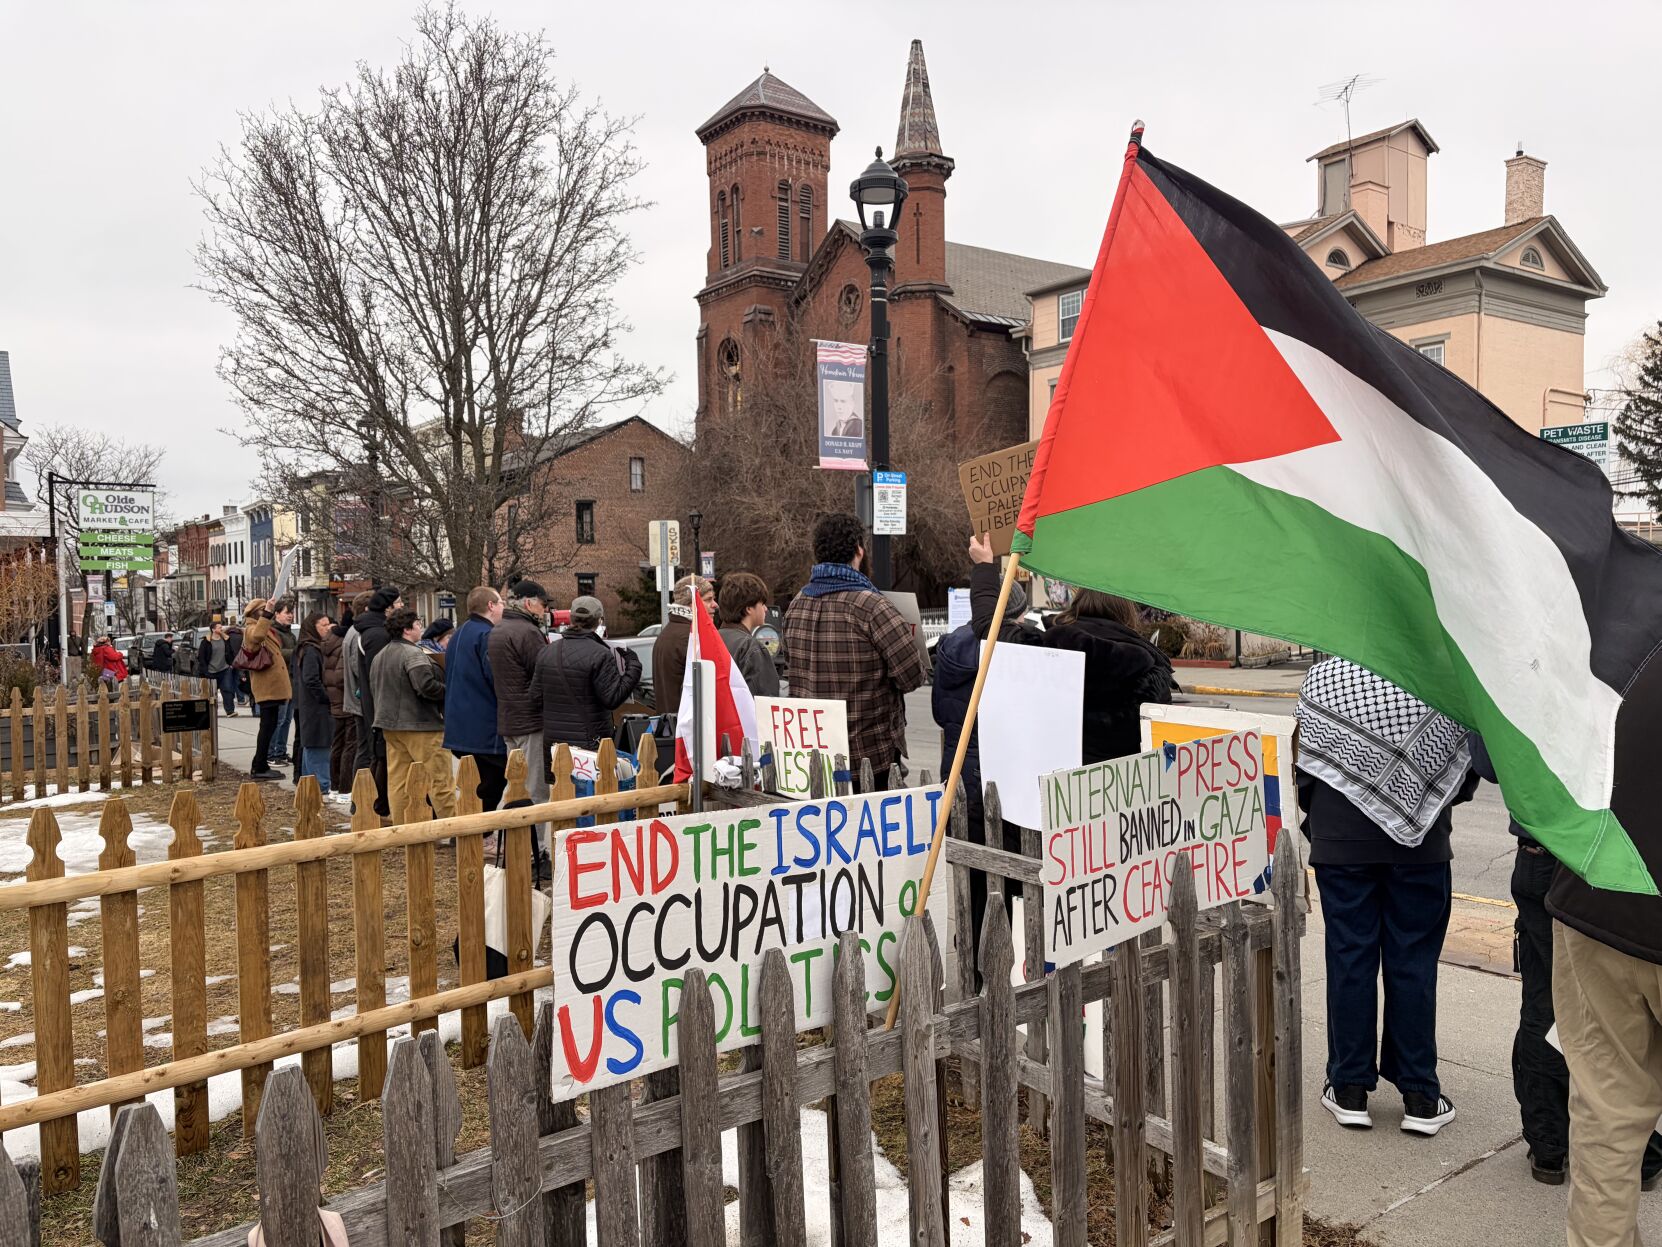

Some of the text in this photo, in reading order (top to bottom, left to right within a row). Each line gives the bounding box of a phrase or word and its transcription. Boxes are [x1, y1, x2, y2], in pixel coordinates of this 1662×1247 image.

[1543, 425, 1604, 439] PET WASTE
[970, 449, 1035, 484] END THE
[105, 494, 136, 505] Olde
[83, 516, 118, 524] MARKET
[97, 534, 137, 543] CHEESE
[100, 548, 134, 556] MEATS
[106, 562, 129, 570] FISH
[771, 705, 829, 749] FREE
[1177, 731, 1259, 800] PRESS
[565, 790, 943, 911] END THE ISRAELI
[1048, 784, 1266, 886] STILL BANNED IN GAZA
[1052, 835, 1251, 953] AFTER CEASFIRE
[569, 859, 884, 995] OCCUPATION
[557, 989, 645, 1084] US
